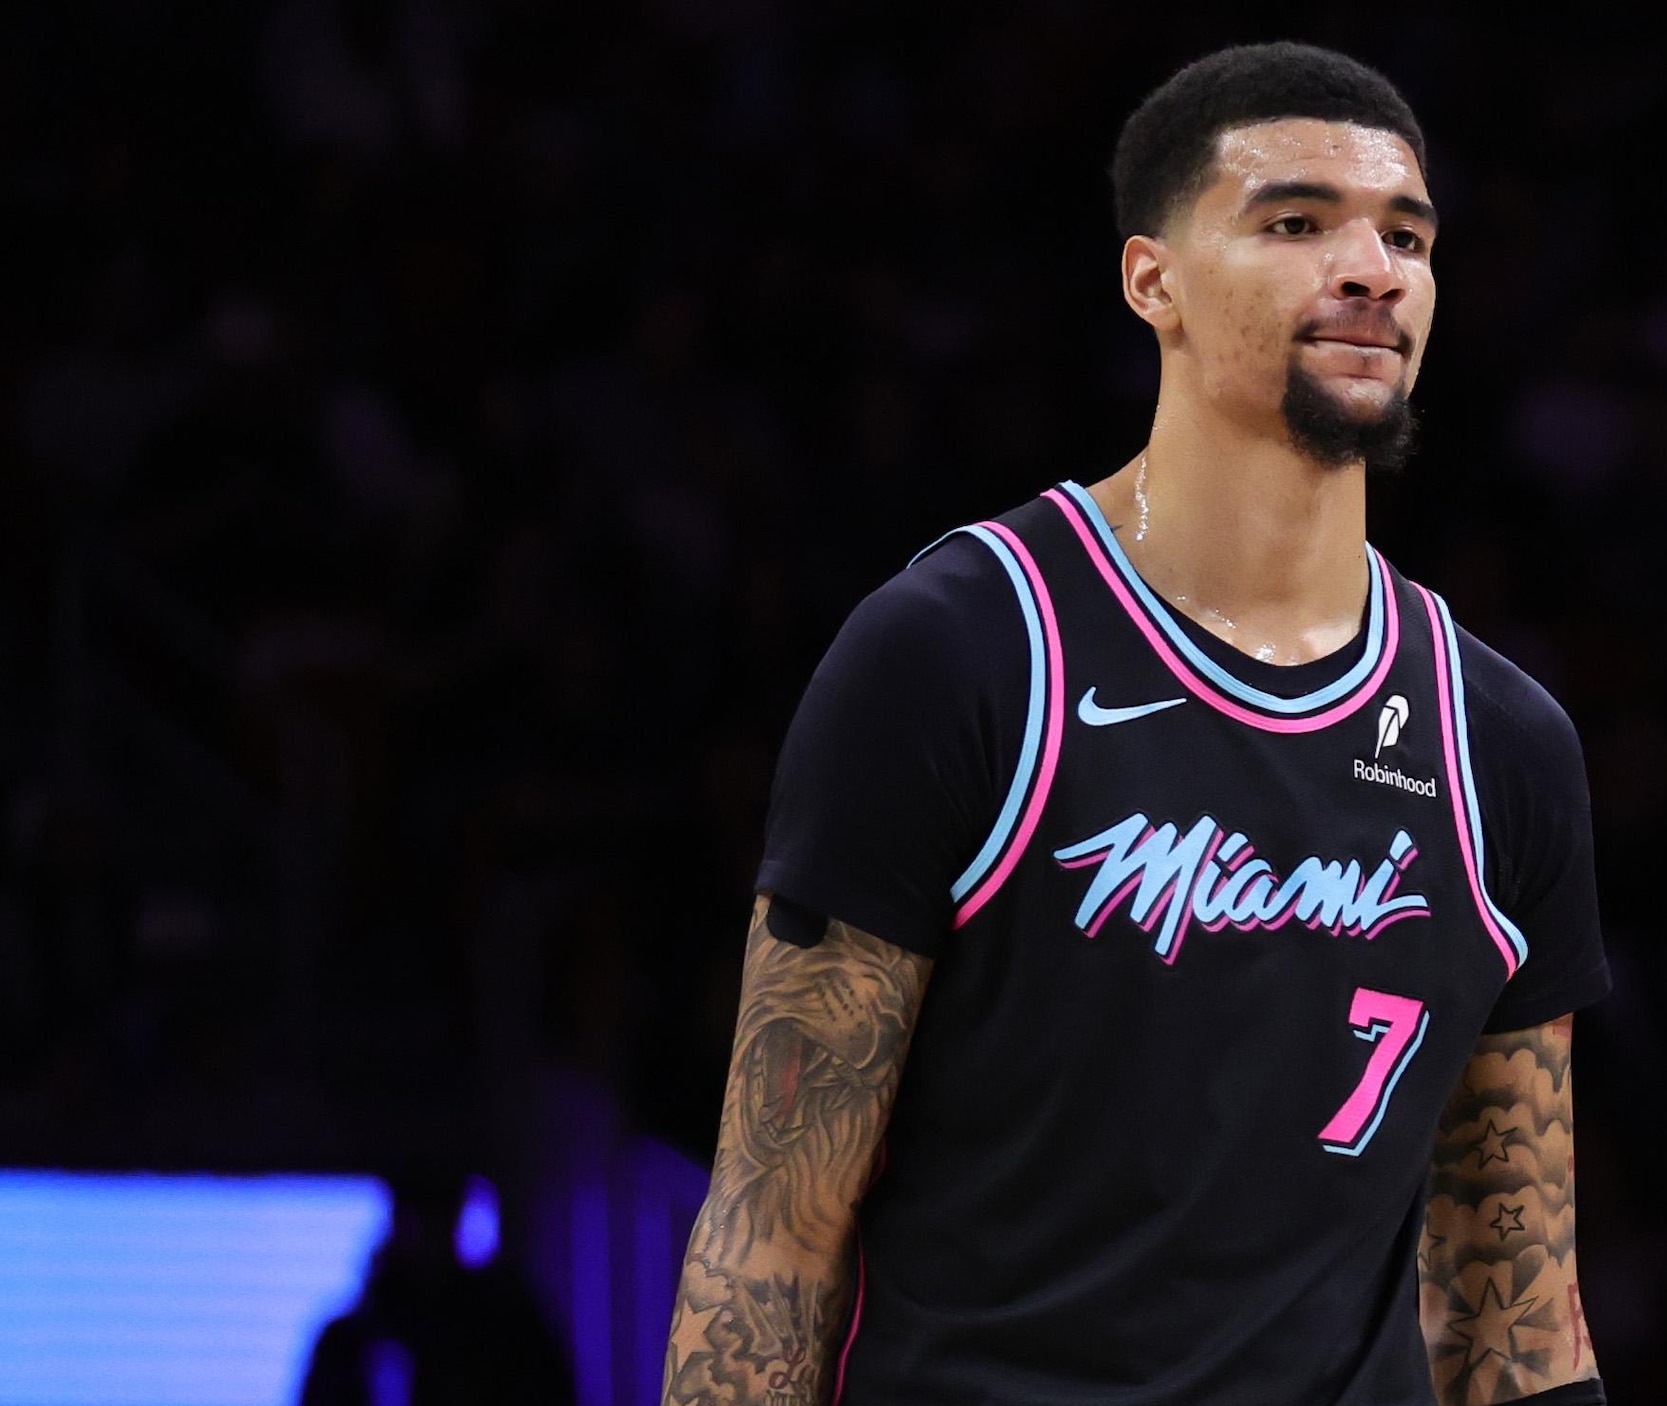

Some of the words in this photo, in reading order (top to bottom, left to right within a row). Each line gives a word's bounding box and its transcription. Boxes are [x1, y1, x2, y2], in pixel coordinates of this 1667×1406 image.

[1353, 759, 1437, 798] Robinhood
[1052, 811, 1431, 966] Miami
[1316, 985, 1430, 1157] 7
